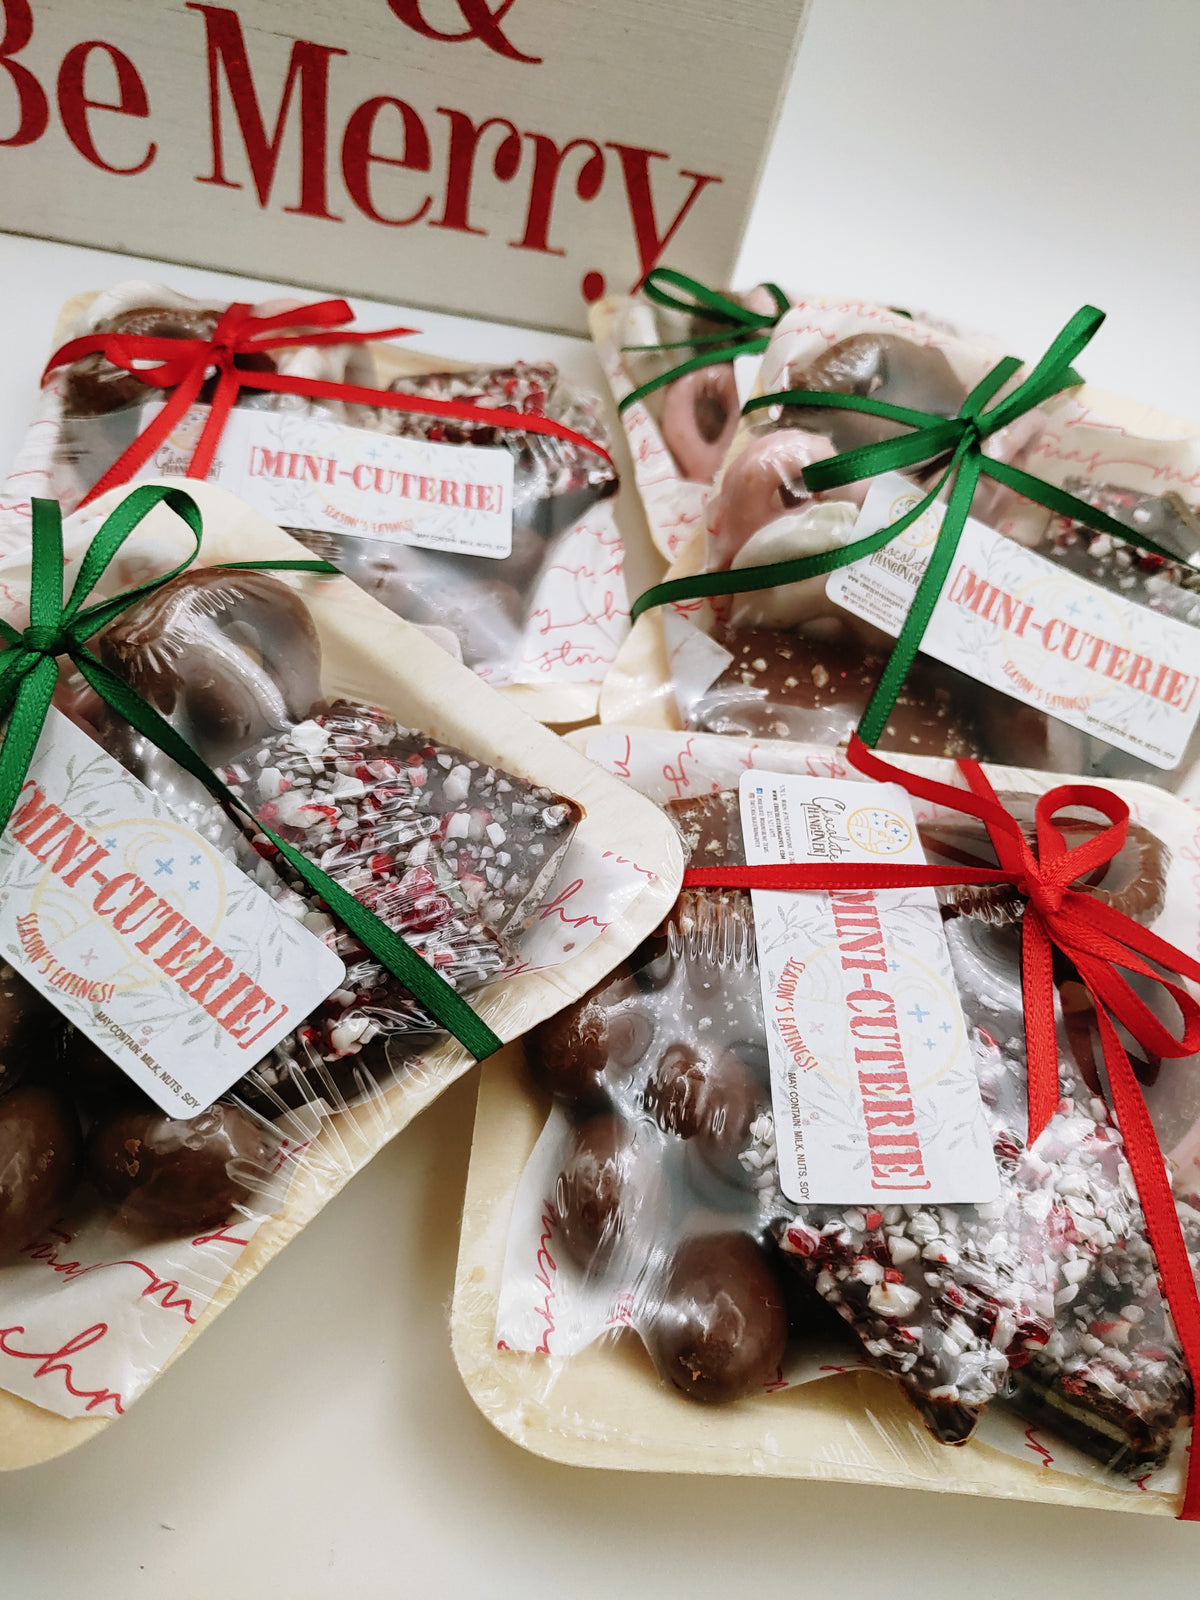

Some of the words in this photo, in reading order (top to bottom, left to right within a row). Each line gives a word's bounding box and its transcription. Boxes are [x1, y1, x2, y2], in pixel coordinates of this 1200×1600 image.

[187, 2, 723, 304] Merry
[812, 796, 851, 863] Chocolate
[16, 912, 57, 975] SEASON'S
[48, 961, 116, 1004] EATINGS!
[775, 956, 806, 1012] SEASON'S
[95, 1010, 114, 1028] MAY
[140, 1053, 163, 1076] MILK,
[159, 1071, 183, 1097] NUTS,
[181, 1091, 202, 1109] SOY
[777, 1017, 819, 1073] EATINGS!
[828, 889, 932, 1191] MINI-CUTERIE]
[788, 1072, 798, 1090] MAY
[793, 1130, 804, 1152] MILK,
[796, 1153, 808, 1179] NUTS,
[799, 1181, 810, 1200] SOY
